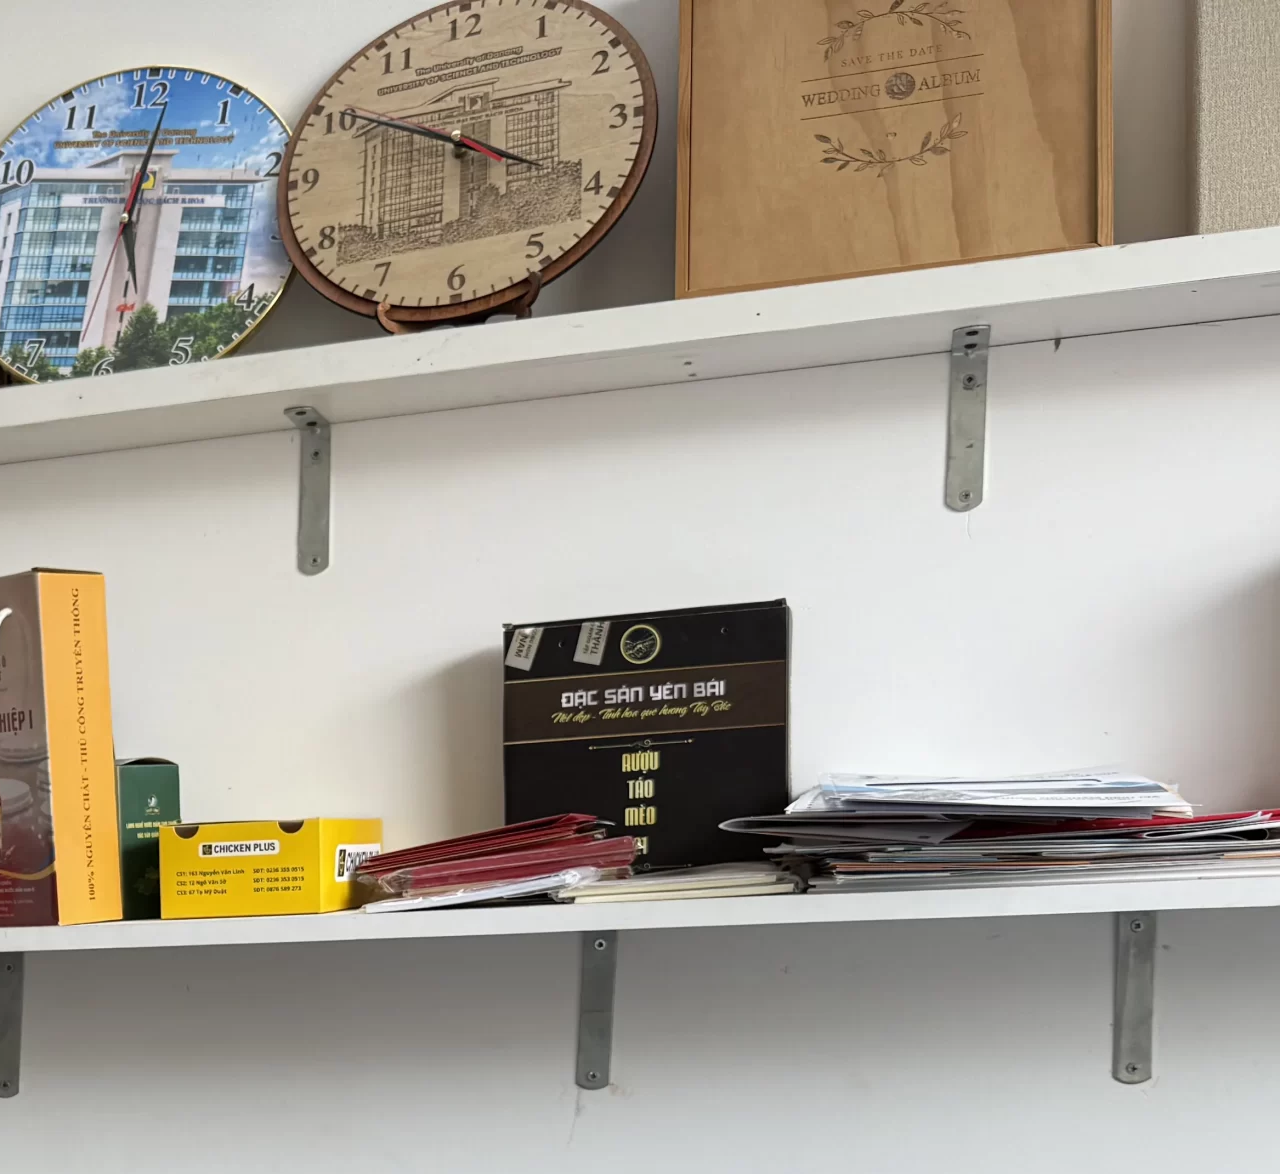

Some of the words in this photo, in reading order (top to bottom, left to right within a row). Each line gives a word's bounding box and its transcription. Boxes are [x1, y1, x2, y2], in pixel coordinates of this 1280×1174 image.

[447, 14, 482, 42] 12
[535, 15, 549, 39] 1
[381, 47, 414, 75] 11
[433, 55, 476, 74] University
[591, 50, 611, 76] 2
[841, 55, 872, 68] SAVE
[878, 50, 903, 62] THE
[910, 44, 943, 57] DATE
[377, 77, 426, 96] UNIVERSITY
[426, 74, 439, 86] OF
[441, 66, 478, 82] SCIENCE
[479, 60, 498, 73] AND
[500, 46, 562, 68] TECHNOLOGY
[801, 84, 880, 108] WEDDING
[918, 69, 981, 91] ALBUM
[323, 107, 357, 136] 10
[609, 103, 628, 129] 3
[302, 168, 320, 193] 9
[583, 170, 604, 196] 4
[318, 225, 336, 250] 8
[525, 232, 545, 258] 5
[374, 262, 391, 287] 7
[447, 264, 466, 291] 6
[561, 689, 598, 709] ĐẶC
[693, 678, 727, 698] BÁI
[627, 777, 654, 799] TÁO
[82, 813, 94, 867] NGUYÊN
[214, 843, 251, 854] CHICKEN
[253, 842, 275, 852] PLUS
[87, 870, 96, 900] 100%
